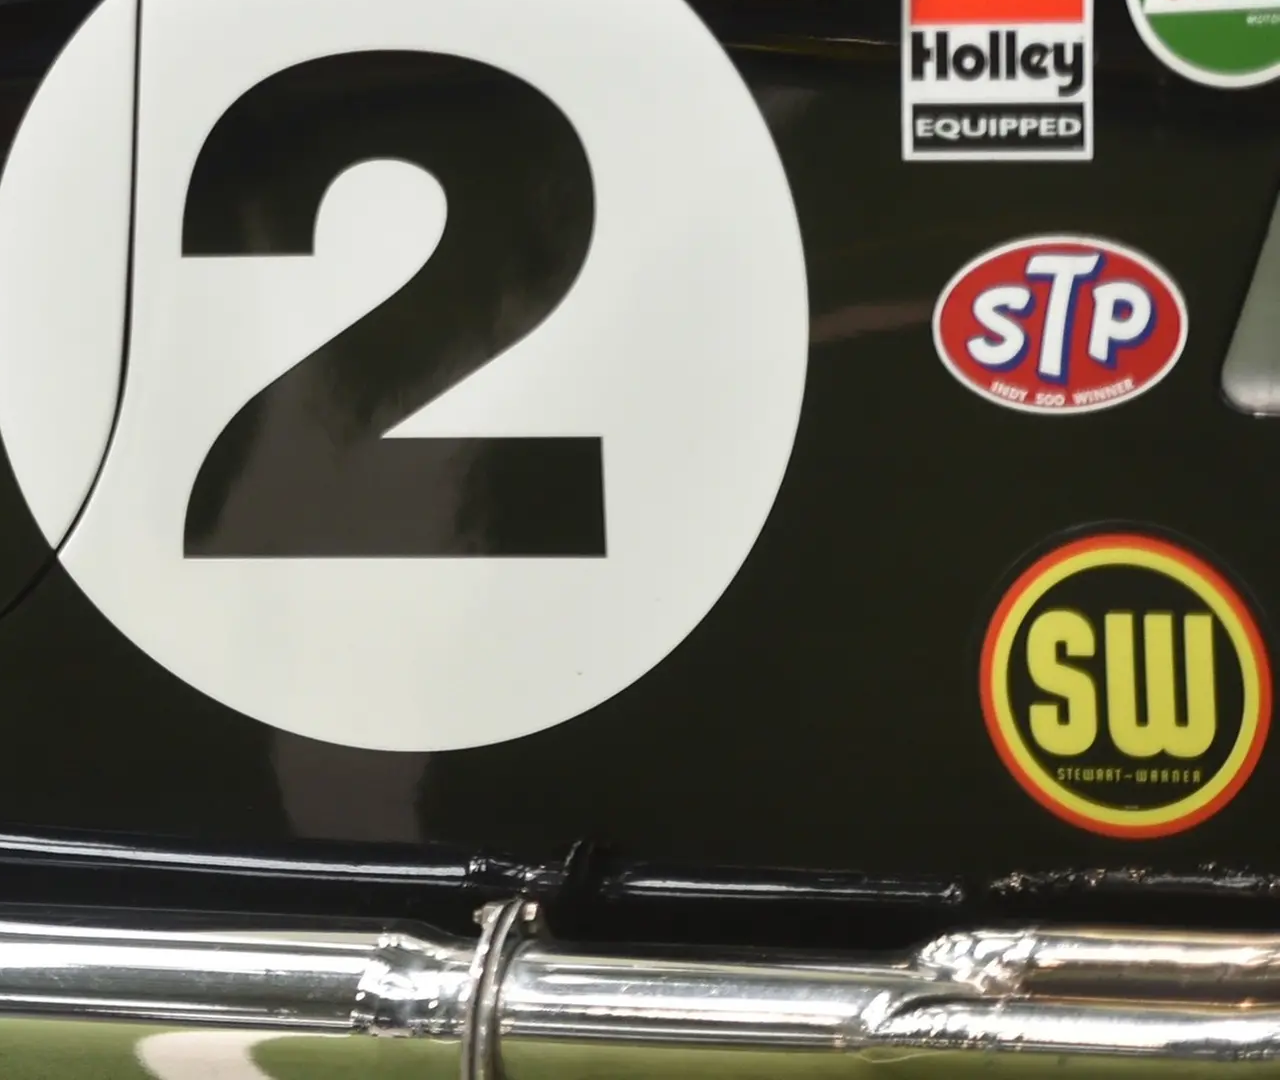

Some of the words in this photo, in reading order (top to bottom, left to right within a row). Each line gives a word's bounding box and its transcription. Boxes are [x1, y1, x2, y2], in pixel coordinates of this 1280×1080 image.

[910, 29, 1085, 98] Holley
[915, 116, 1082, 140] EQUIPPED
[180, 47, 609, 559] 2
[965, 252, 1157, 383] STP
[991, 380, 1028, 402] INDY
[1035, 392, 1066, 407] 500
[1072, 378, 1135, 406] WINNER
[1026, 609, 1217, 759] SW
